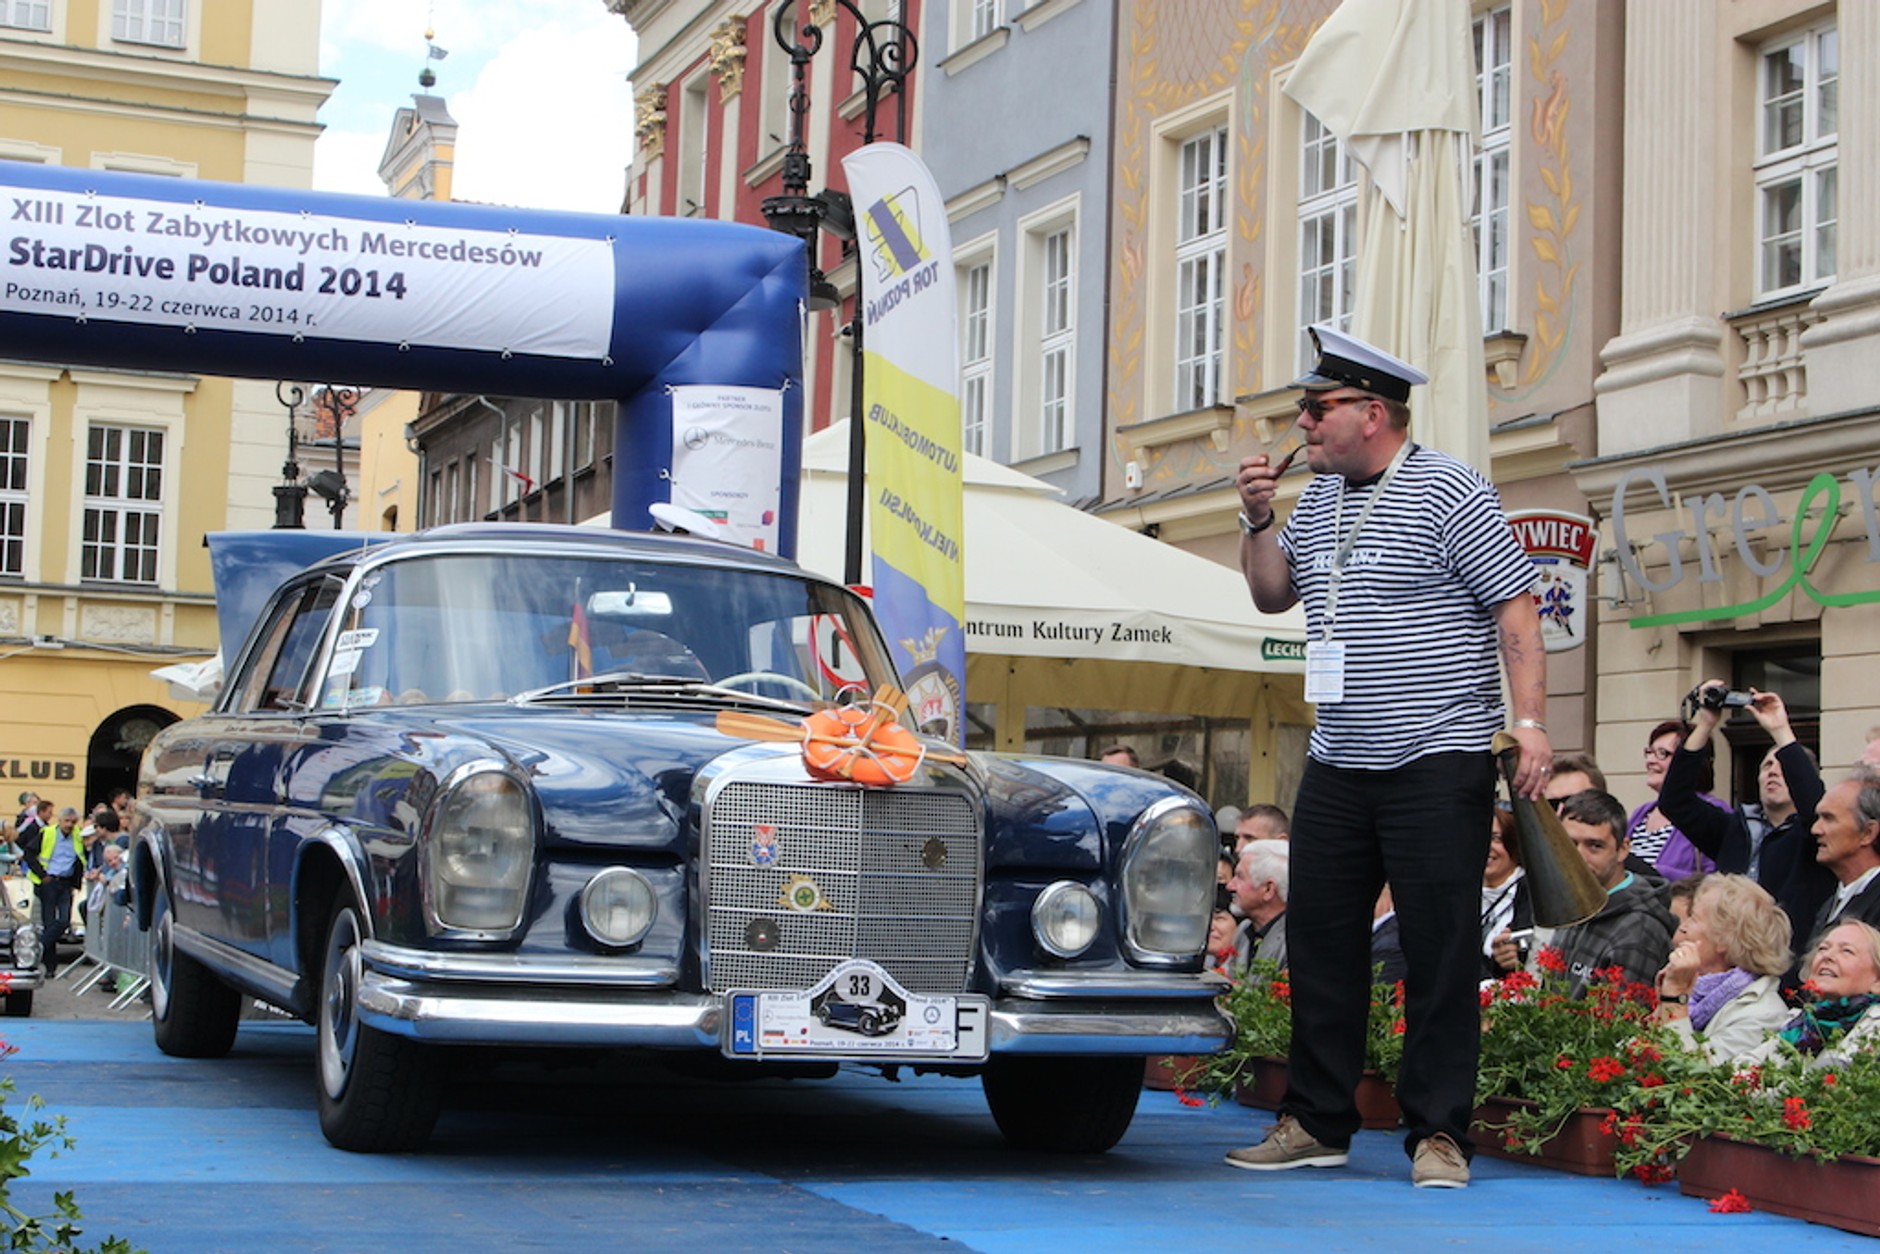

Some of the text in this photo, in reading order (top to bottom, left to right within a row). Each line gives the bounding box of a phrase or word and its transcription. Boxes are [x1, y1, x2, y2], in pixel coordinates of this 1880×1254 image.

[10, 198, 543, 267] XIII Zlot Zabytkowych Mercedesów
[8, 236, 407, 300] StarDrive Poland 2014
[5, 282, 318, 327] Poznań, 19-22 czerwca 2014 r.
[1033, 621, 1104, 645] Kultury
[1111, 622, 1173, 644] Zamek
[849, 974, 870, 996] 33
[735, 1030, 751, 1043] PL
